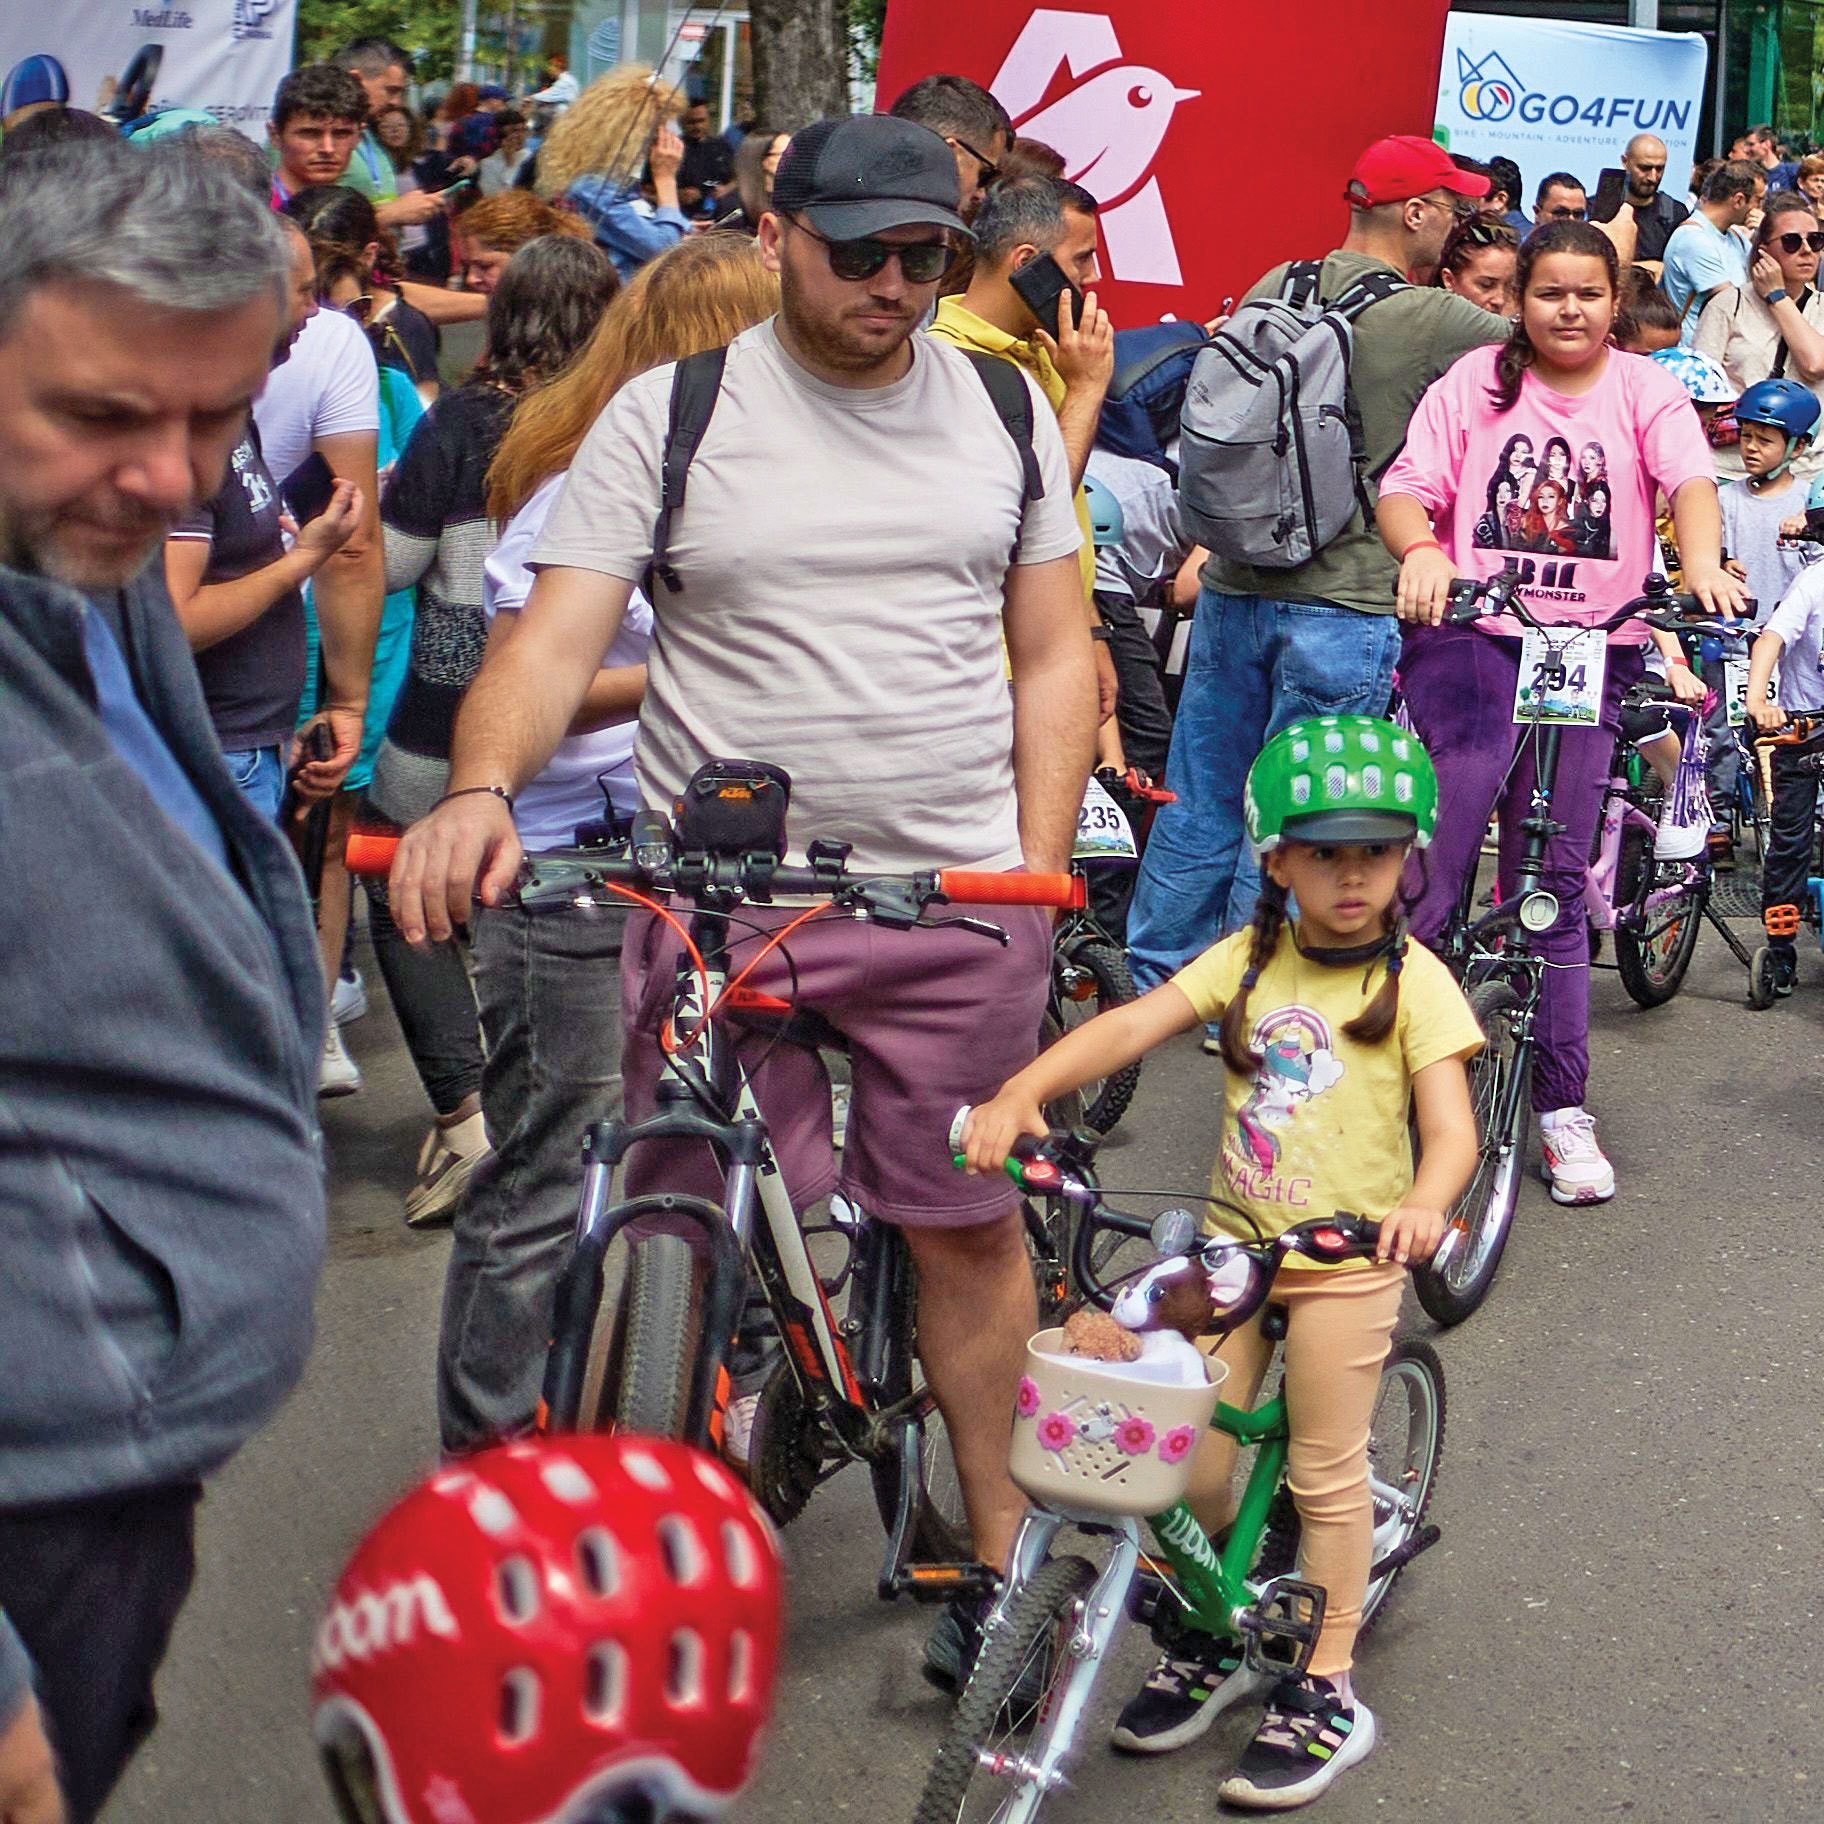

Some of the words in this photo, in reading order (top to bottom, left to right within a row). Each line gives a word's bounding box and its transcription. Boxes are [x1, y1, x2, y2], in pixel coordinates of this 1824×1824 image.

[1519, 92, 1692, 131] GO4FUN
[1531, 662, 1587, 692] 294
[1736, 681, 1777, 703] 53
[1078, 805, 1121, 830] 235
[311, 1570, 464, 1676] oom
